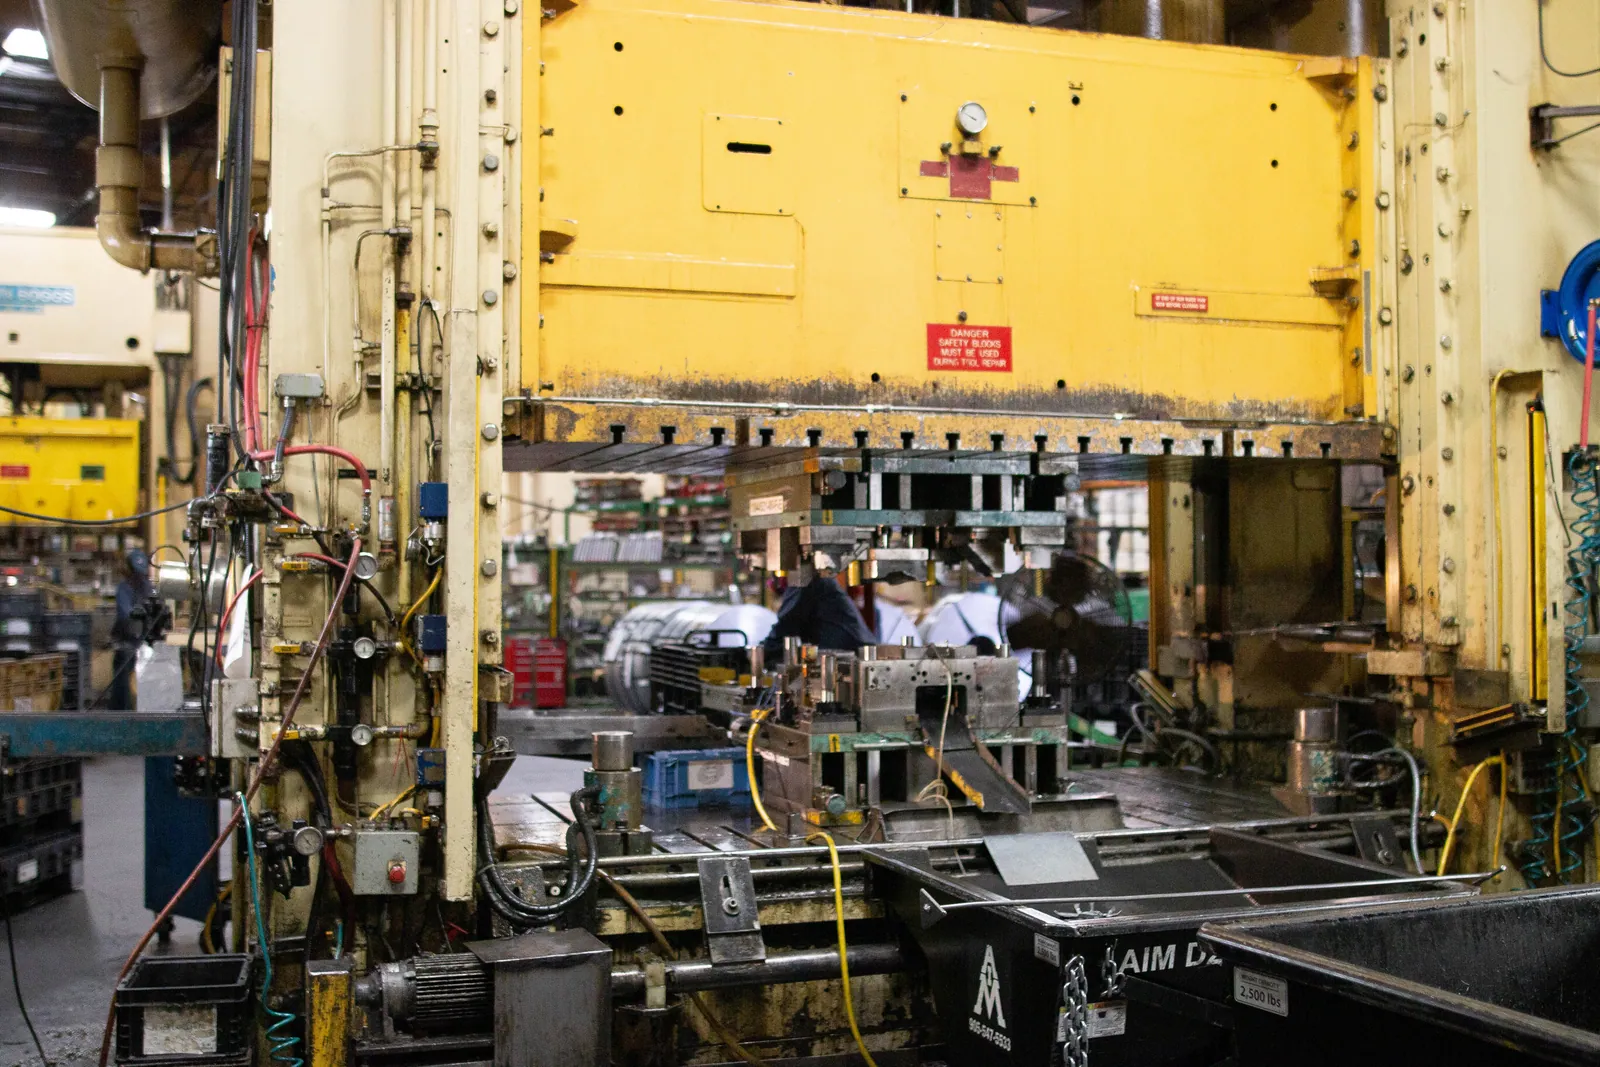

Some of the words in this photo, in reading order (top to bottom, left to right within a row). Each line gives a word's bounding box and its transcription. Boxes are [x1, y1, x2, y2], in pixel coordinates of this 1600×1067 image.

[950, 328, 989, 338] DANGER
[938, 338, 969, 347] SAFETY
[971, 339, 1002, 349] BLOCKS
[940, 348, 962, 357] MUST
[965, 348, 976, 357] BE
[979, 349, 1000, 358] USED
[961, 358, 980, 368] TOOL
[982, 359, 1007, 368] REPAIR
[1118, 944, 1176, 974] AIM
[1240, 985, 1265, 1003] 2,500
[1267, 993, 1281, 1008] lbs
